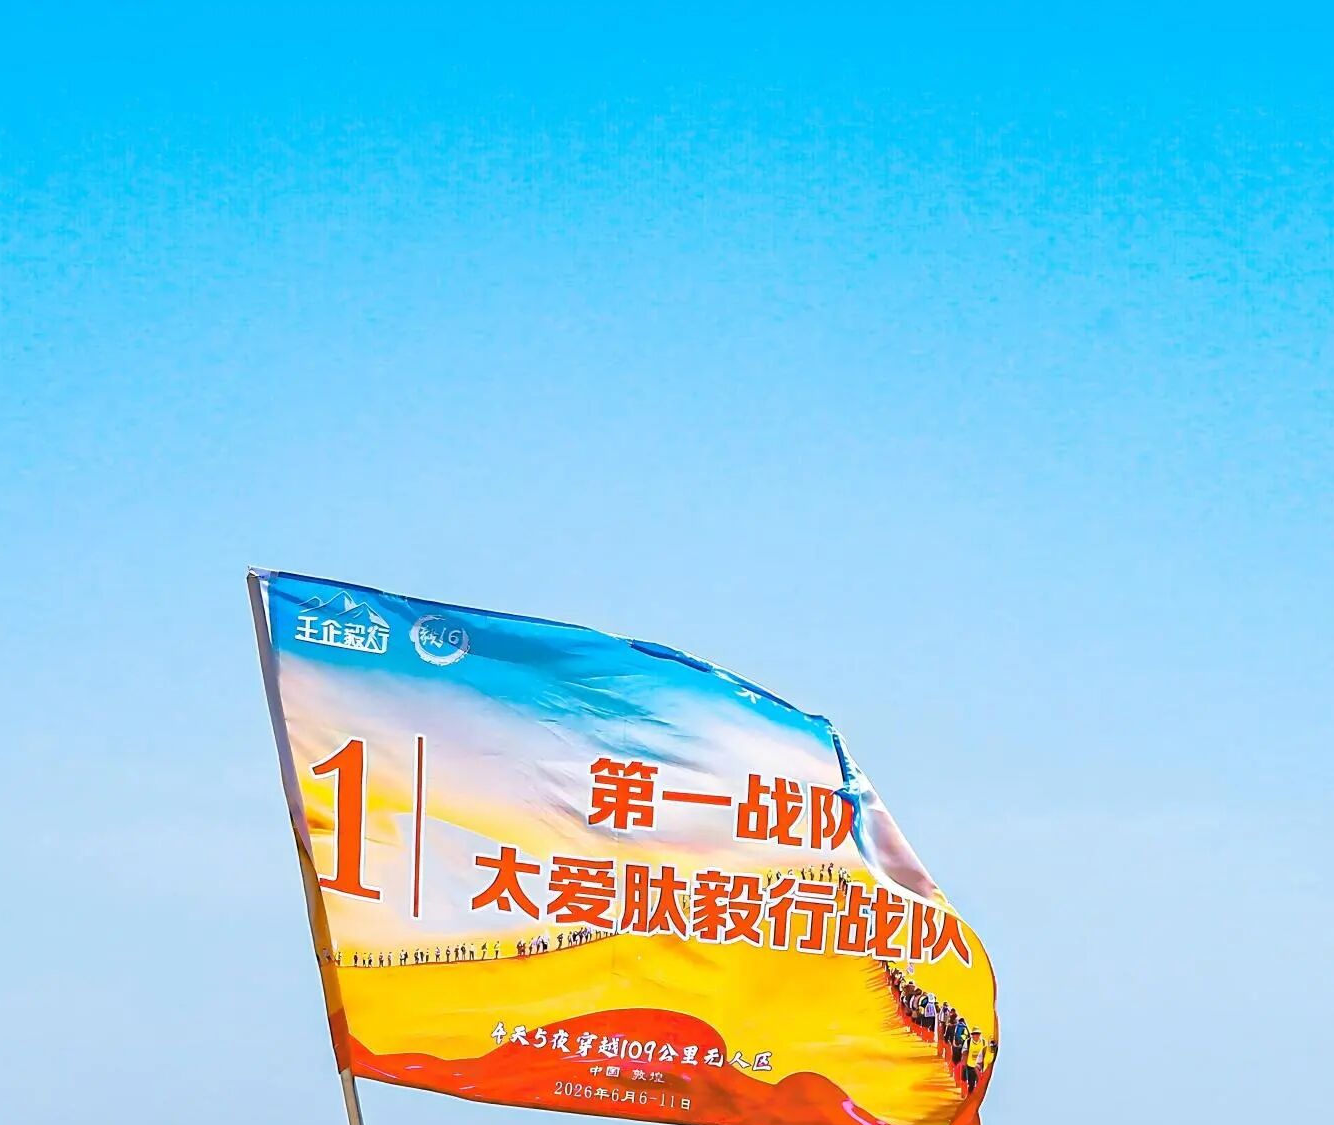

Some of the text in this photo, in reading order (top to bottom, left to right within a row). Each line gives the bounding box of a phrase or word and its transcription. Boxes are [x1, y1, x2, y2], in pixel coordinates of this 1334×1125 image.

[310, 738, 382, 901] 1
[587, 757, 854, 850] 第一战队
[471, 846, 973, 967] 太爱肽毅行战队
[589, 1065, 666, 1084] 中国 敦煌
